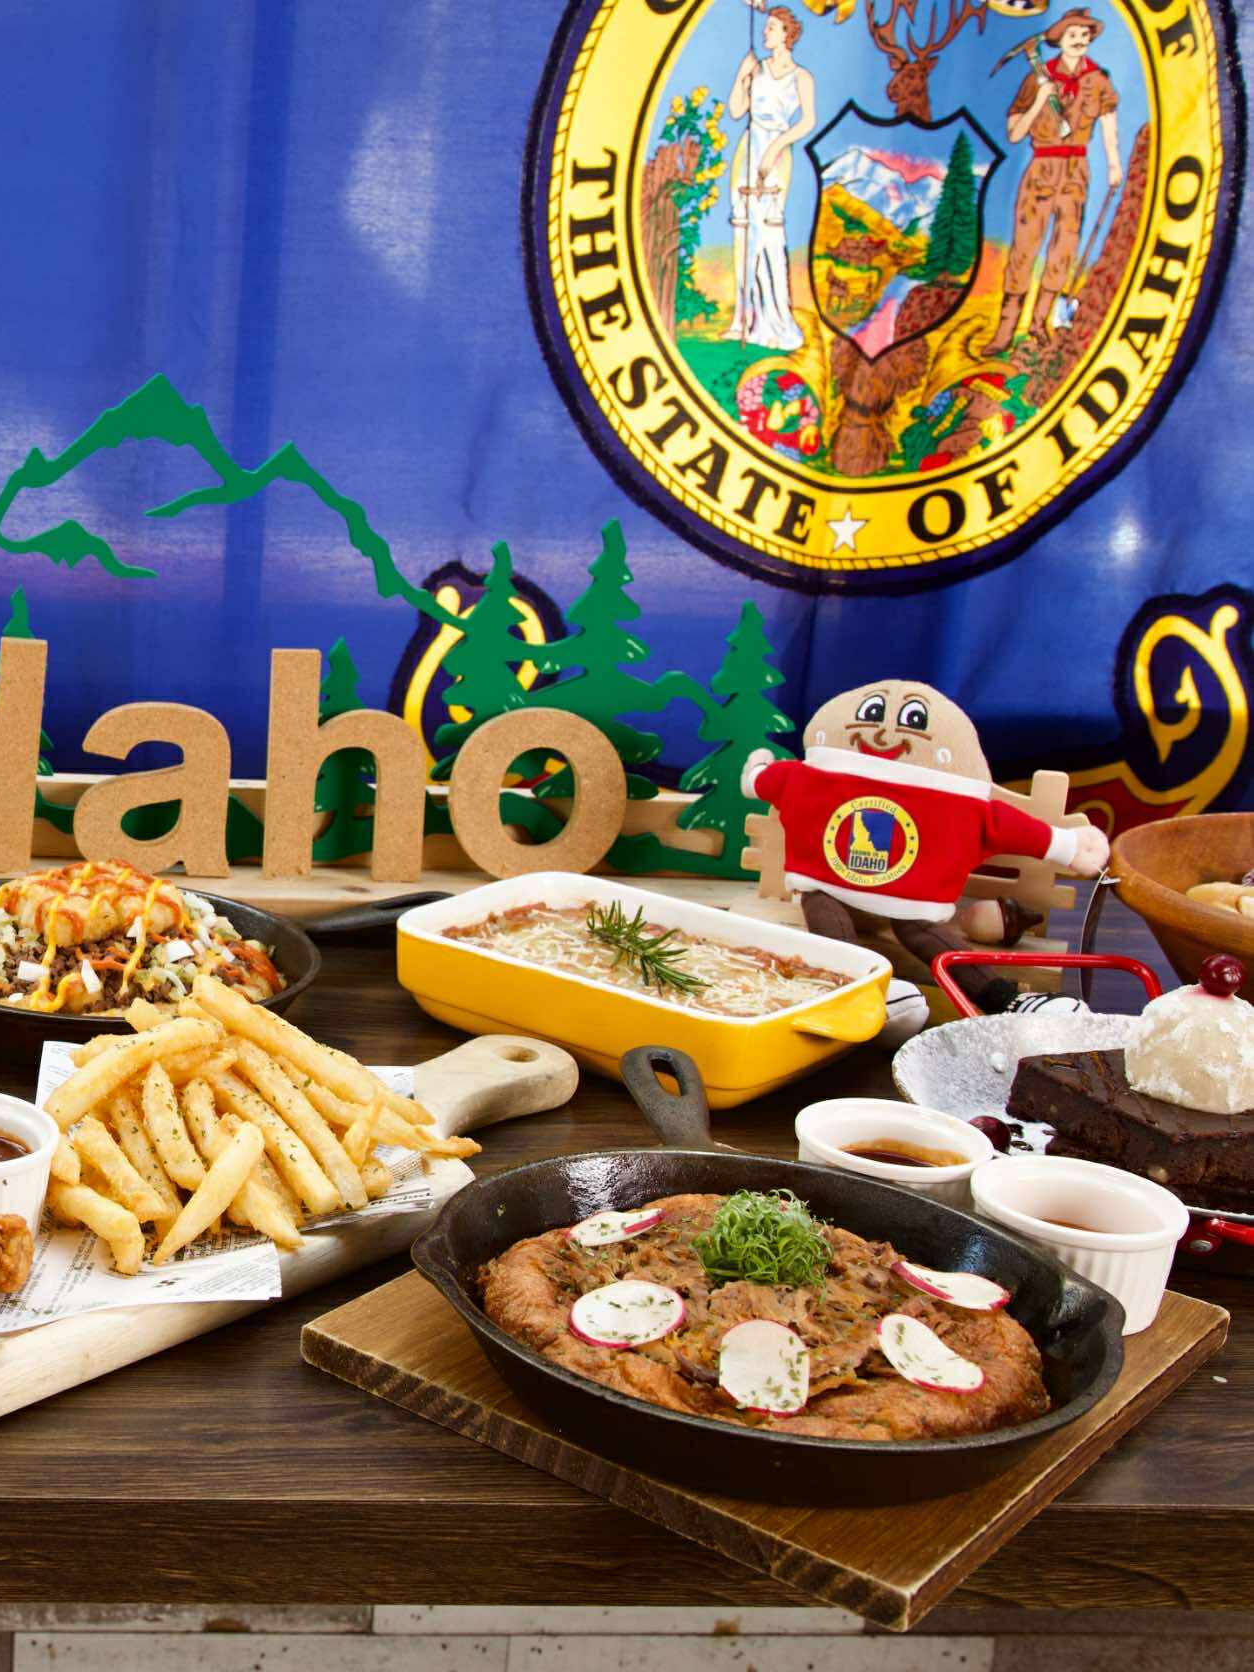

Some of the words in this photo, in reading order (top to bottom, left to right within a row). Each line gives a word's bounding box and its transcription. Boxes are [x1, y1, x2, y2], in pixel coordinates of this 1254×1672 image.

[1142, 0, 1199, 58] F
[570, 149, 632, 342] THE
[608, 355, 817, 546] STATE
[907, 460, 1020, 544] OF
[1046, 155, 1205, 468] IDAHO
[851, 799, 898, 814] Certified
[850, 855, 886, 871] IDAHO
